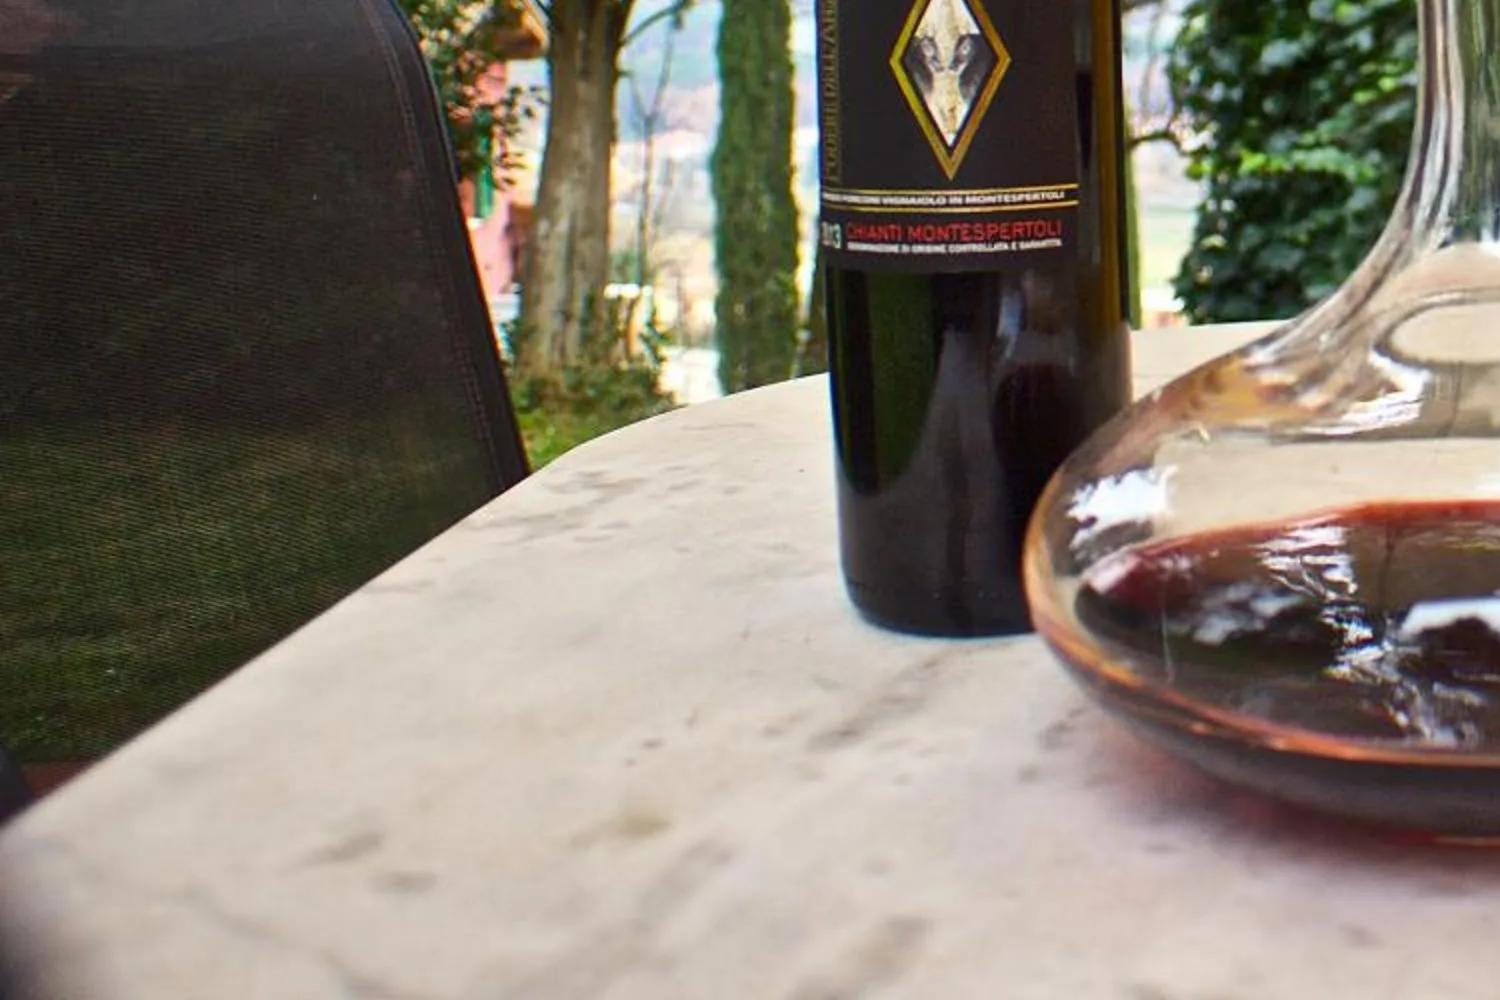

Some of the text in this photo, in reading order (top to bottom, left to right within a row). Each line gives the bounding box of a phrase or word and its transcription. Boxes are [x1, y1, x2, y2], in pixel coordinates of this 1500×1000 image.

[965, 191, 1065, 205] MONTESPERTOLI
[846, 219, 1062, 243] CHIANTI MONTESPERTOLI
